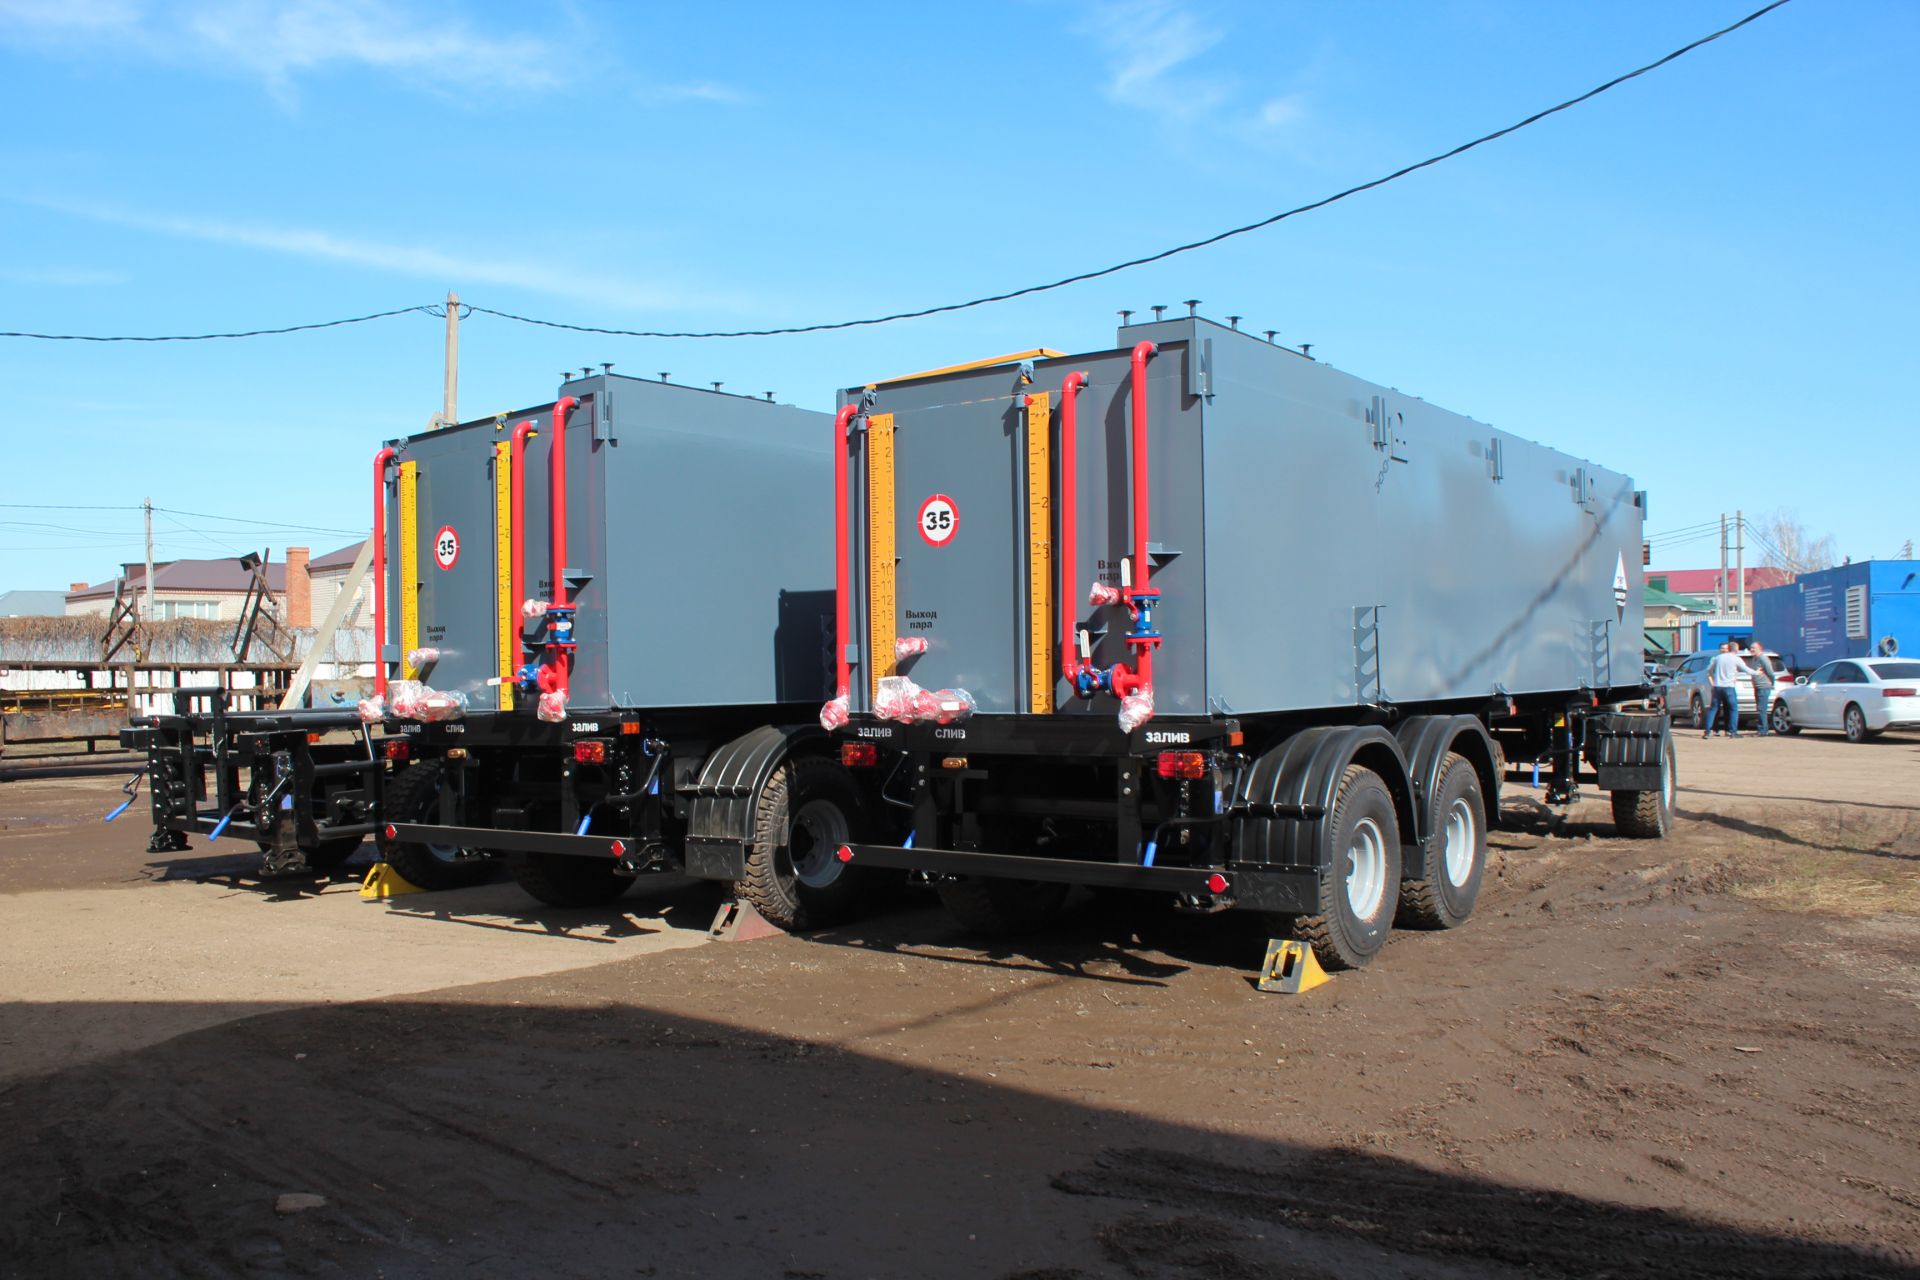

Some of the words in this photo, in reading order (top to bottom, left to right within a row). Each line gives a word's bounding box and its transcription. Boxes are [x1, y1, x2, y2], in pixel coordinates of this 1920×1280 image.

[885, 446, 892, 458] 2
[1041, 496, 1049, 509] 2
[926, 510, 951, 531] 35
[439, 539, 455, 556] 35
[881, 580, 892, 593] 11
[881, 594, 893, 606] 12
[881, 609, 893, 621] 13
[905, 609, 938, 621] Выход
[909, 620, 933, 631] пара
[400, 724, 421, 734] залив
[445, 724, 465, 734] слив
[572, 722, 599, 733] залив
[857, 727, 893, 738] залив
[934, 728, 966, 740] слив
[1145, 731, 1191, 744] залив
